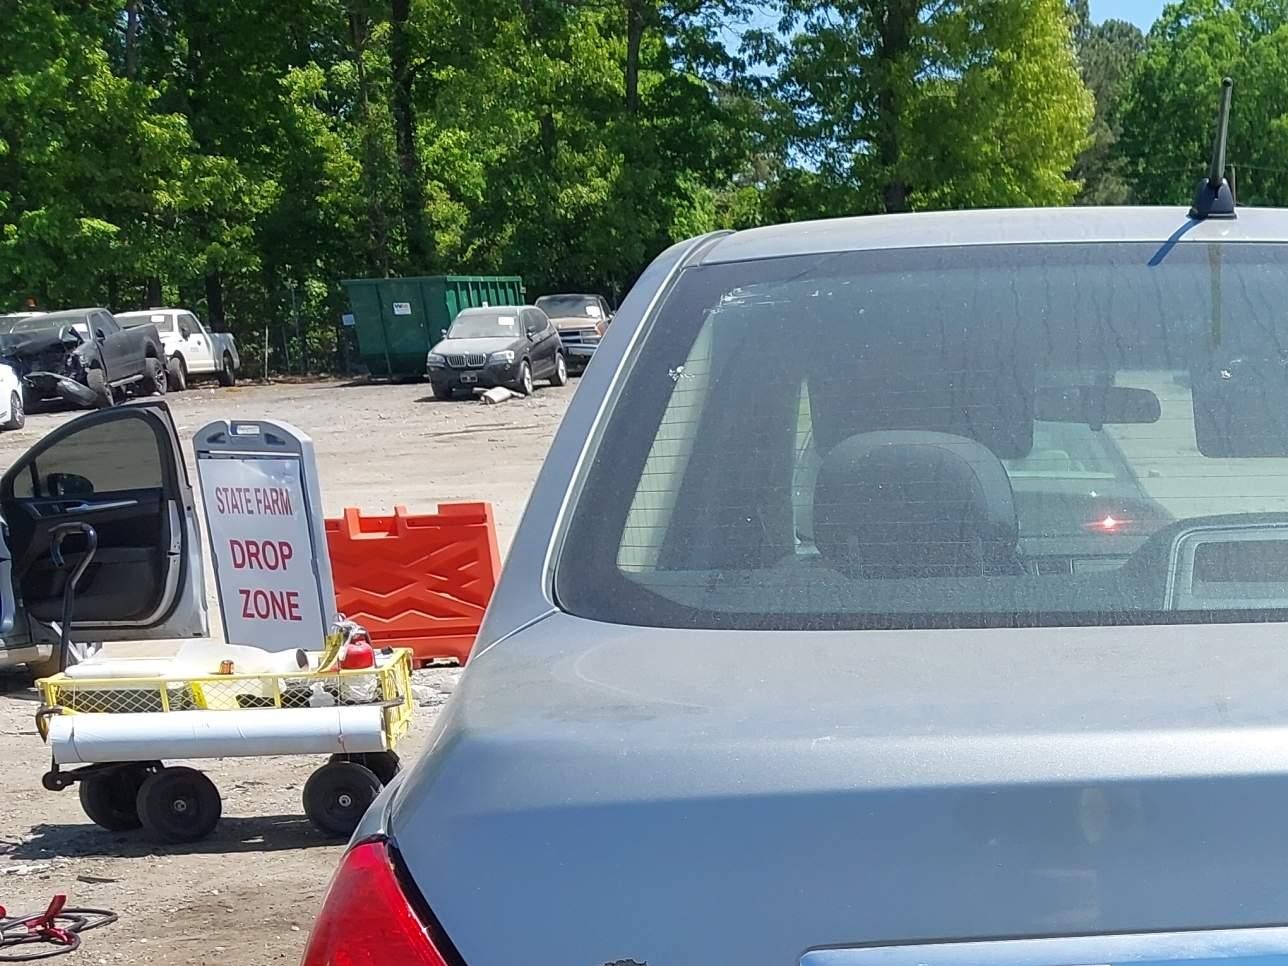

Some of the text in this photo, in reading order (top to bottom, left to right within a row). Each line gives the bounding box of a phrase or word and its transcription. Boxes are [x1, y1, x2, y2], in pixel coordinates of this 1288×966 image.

[215, 486, 293, 515] STATE FARM
[229, 539, 293, 570] DROP
[239, 589, 303, 621] ZONE
